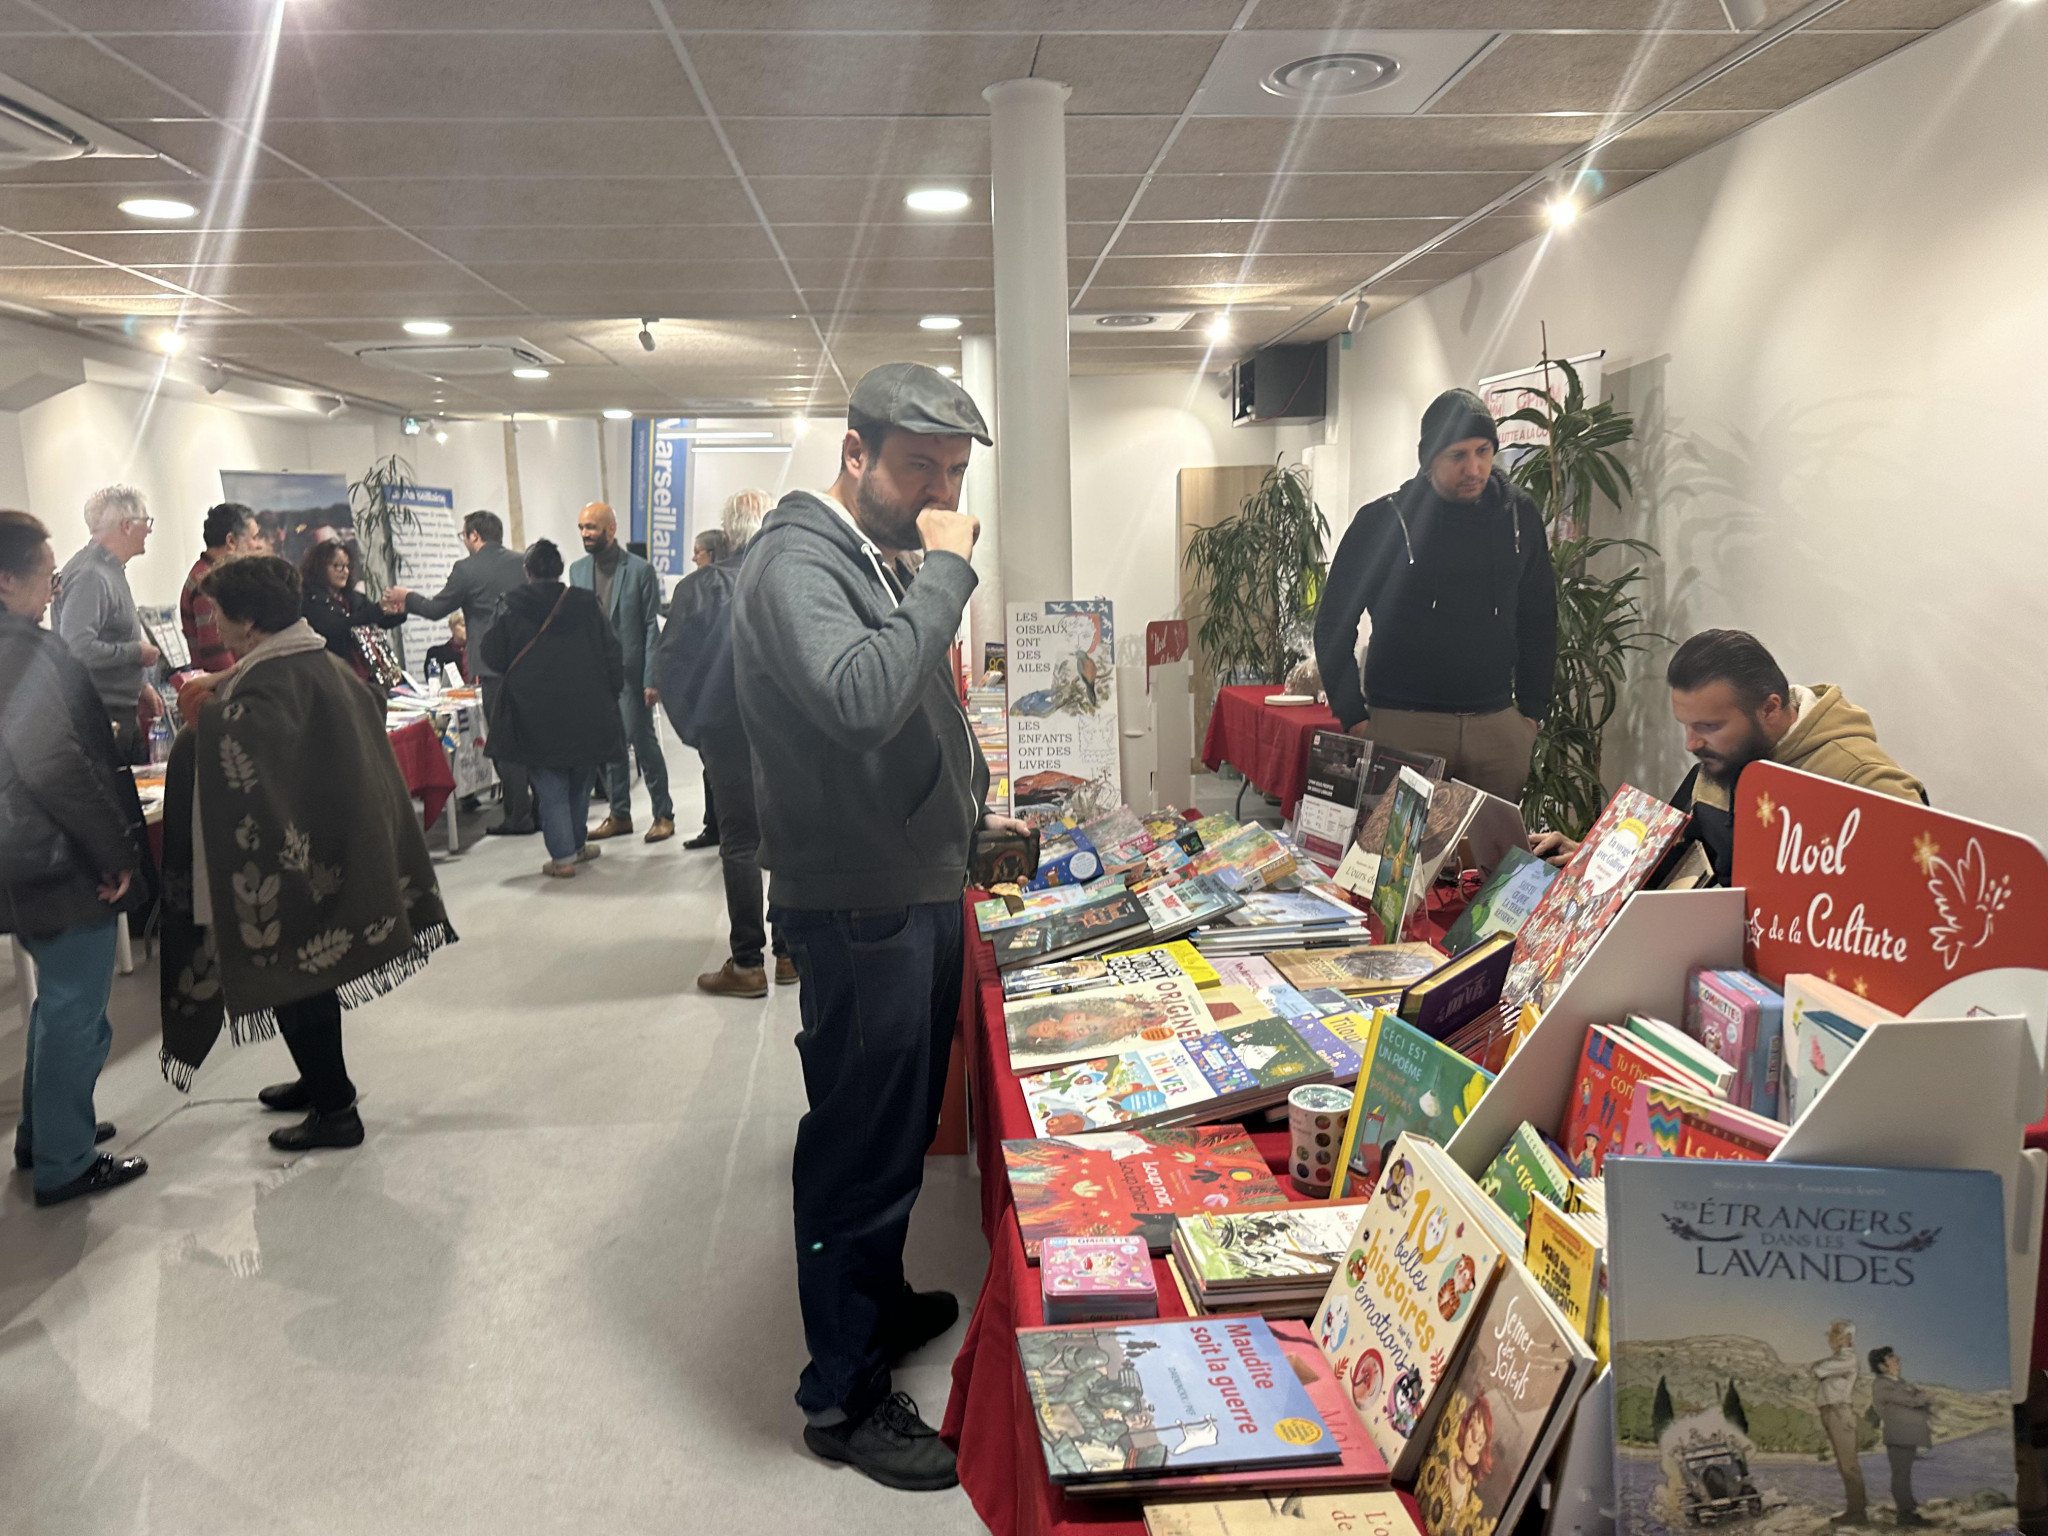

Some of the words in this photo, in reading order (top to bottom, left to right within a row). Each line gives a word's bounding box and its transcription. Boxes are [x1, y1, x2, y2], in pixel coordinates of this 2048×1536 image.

[1016, 612, 1038, 622] LES
[1016, 624, 1068, 635] OISEAUX
[1016, 637, 1041, 648] ONT
[1017, 650, 1041, 660] DES
[1017, 663, 1051, 673] AILES
[1018, 721, 1040, 731] LES
[1018, 733, 1073, 744] ENFANTS
[1018, 746, 1043, 757] ONT
[1046, 746, 1071, 756] DES
[1019, 759, 1062, 770] LIVRES
[1776, 806, 1861, 876] Noël
[1769, 914, 1785, 941] de
[1788, 915, 1802, 944] la
[1806, 892, 1908, 963] Culture
[1378, 1043, 1393, 1061] UN
[1382, 1026, 1406, 1050] CECI
[1408, 1042, 1428, 1063] EST
[1616, 1052, 1629, 1075] Tu
[1505, 1142, 1520, 1166] Le
[1696, 1197, 1913, 1236] ÉTRANGERS
[1761, 1231, 1813, 1248] DANS
[1815, 1234, 1845, 1249] LES
[1394, 1231, 1428, 1293] belles
[1696, 1246, 1916, 1288] LAVANDES
[1365, 1228, 1436, 1354] histoires
[1354, 1281, 1409, 1372] émotions
[1493, 1295, 1536, 1354] Semer
[1189, 1325, 1221, 1358] soit
[1207, 1356, 1228, 1381] la
[1224, 1322, 1275, 1391] Maudite
[1207, 1374, 1260, 1436] guerre
